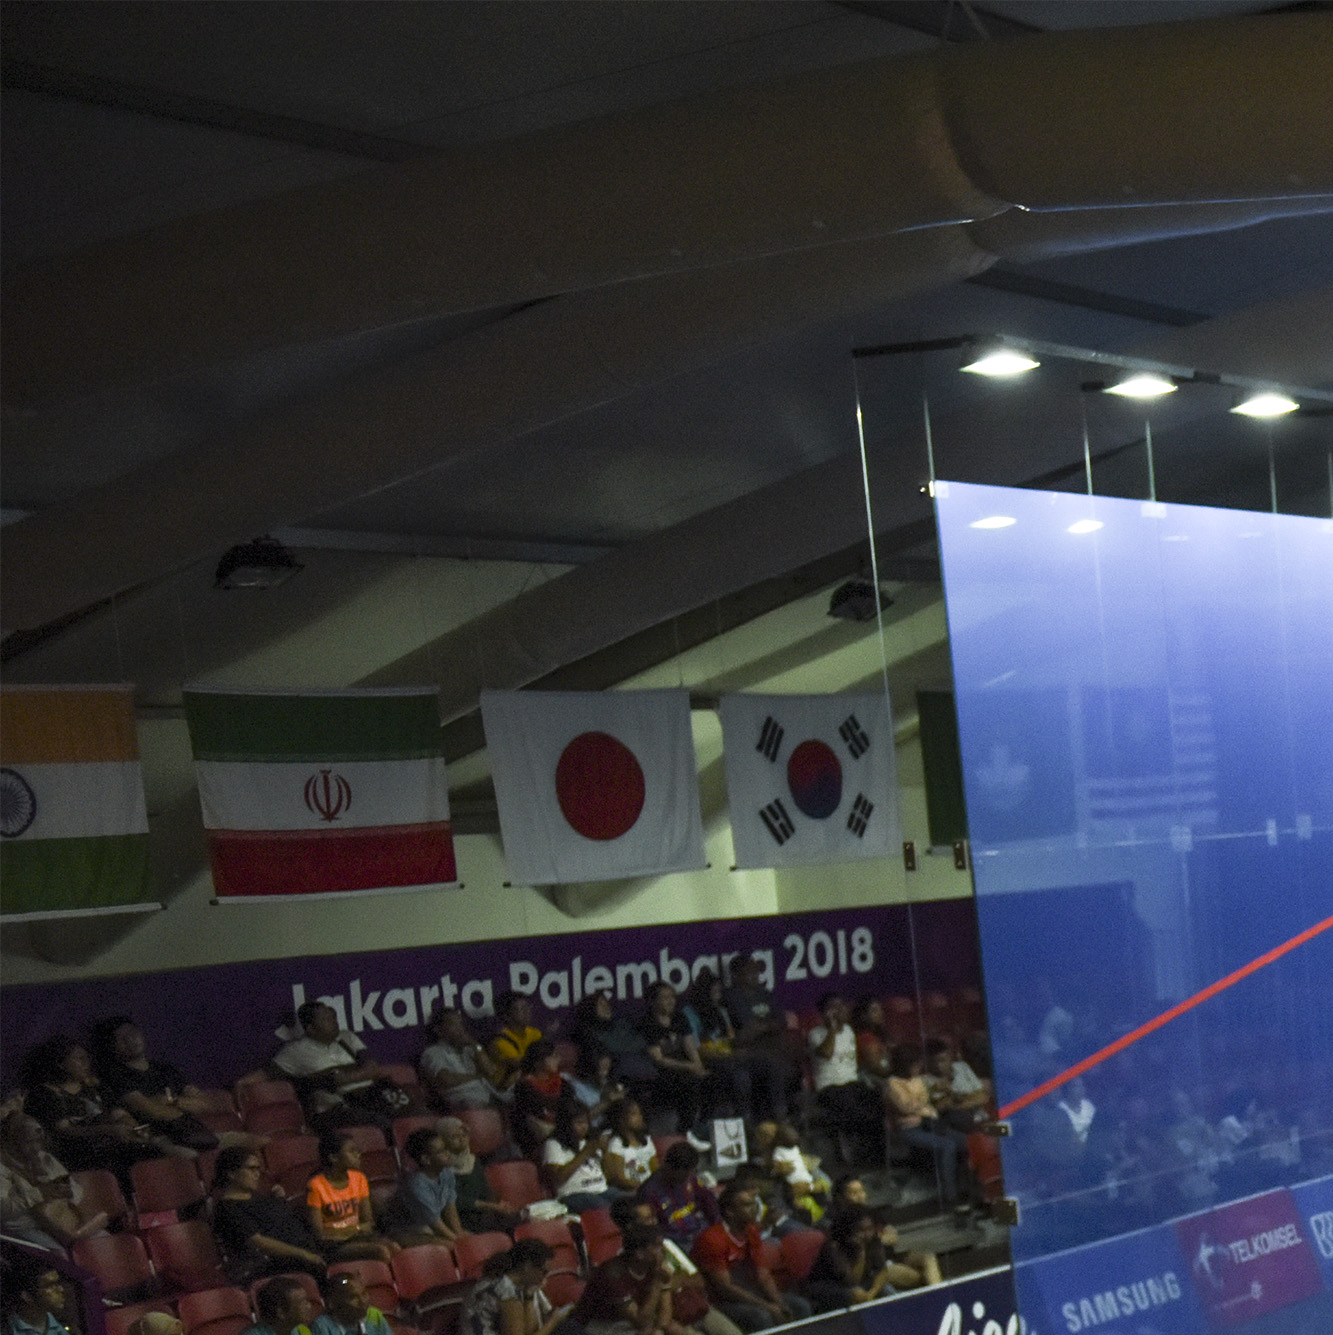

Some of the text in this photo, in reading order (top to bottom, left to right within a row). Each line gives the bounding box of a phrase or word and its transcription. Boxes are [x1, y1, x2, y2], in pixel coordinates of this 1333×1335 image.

[784, 926, 876, 982] 2018
[1229, 1223, 1302, 1264] TELKOMSEL
[1062, 1271, 1182, 1333] SAMSUNG
